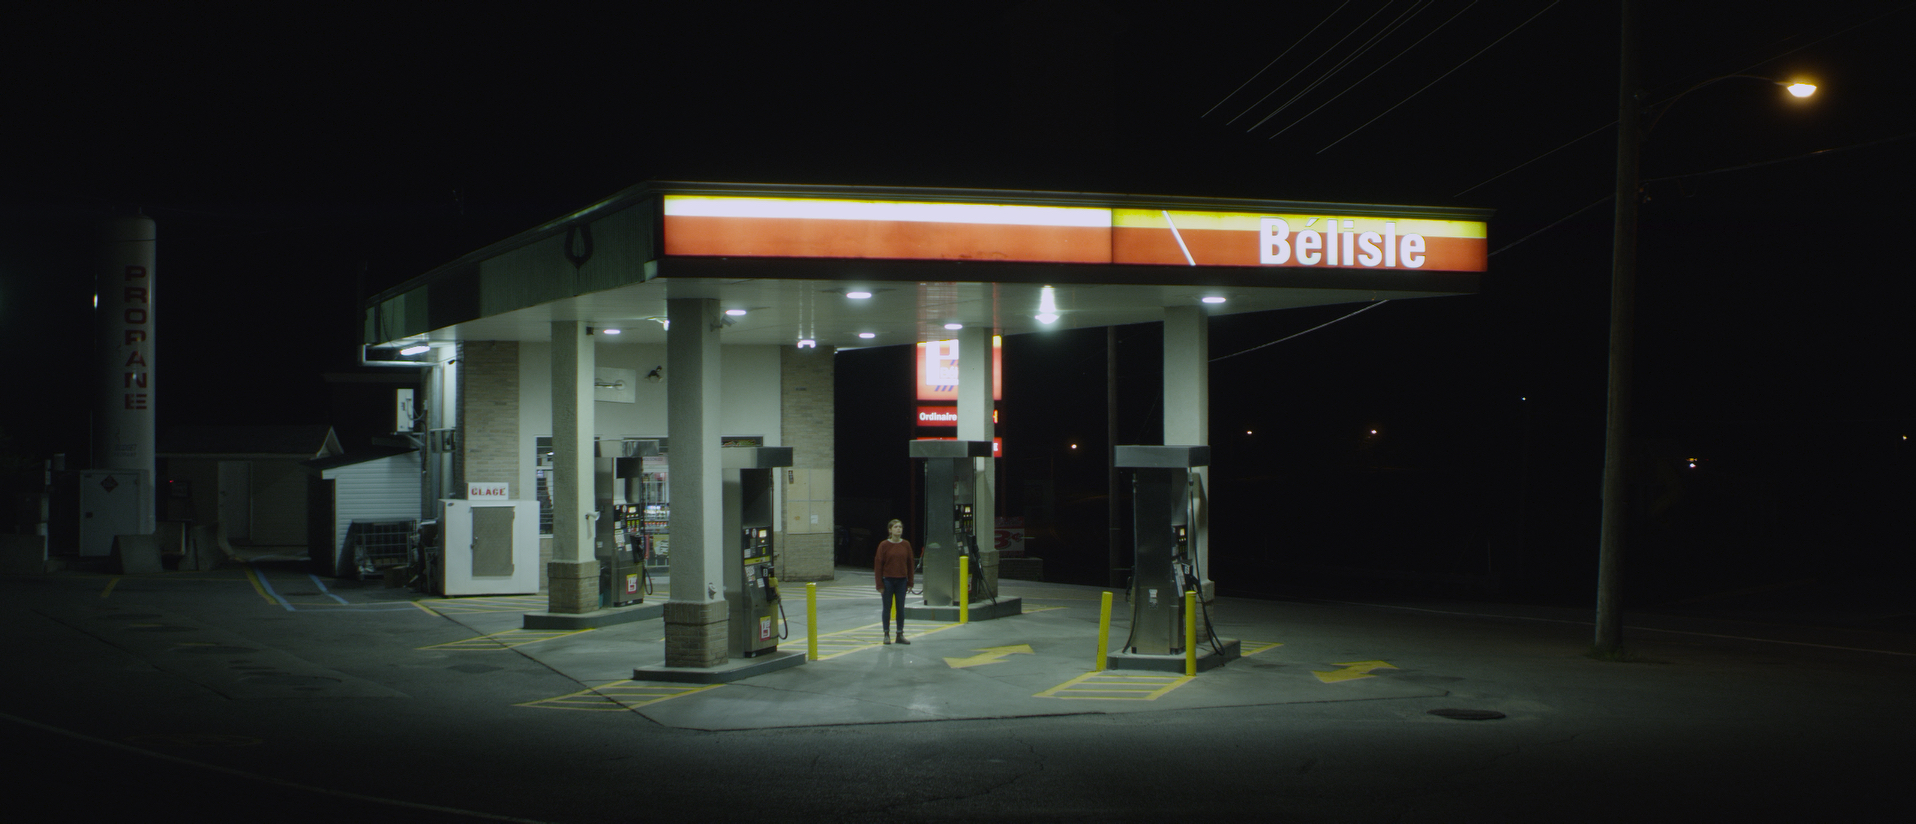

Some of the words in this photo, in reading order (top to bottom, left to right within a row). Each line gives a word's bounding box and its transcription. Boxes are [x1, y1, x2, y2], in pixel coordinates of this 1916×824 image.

[1260, 216, 1426, 268] Bélisle
[124, 265, 147, 410] PROPANE
[919, 412, 958, 421] Ordinaire
